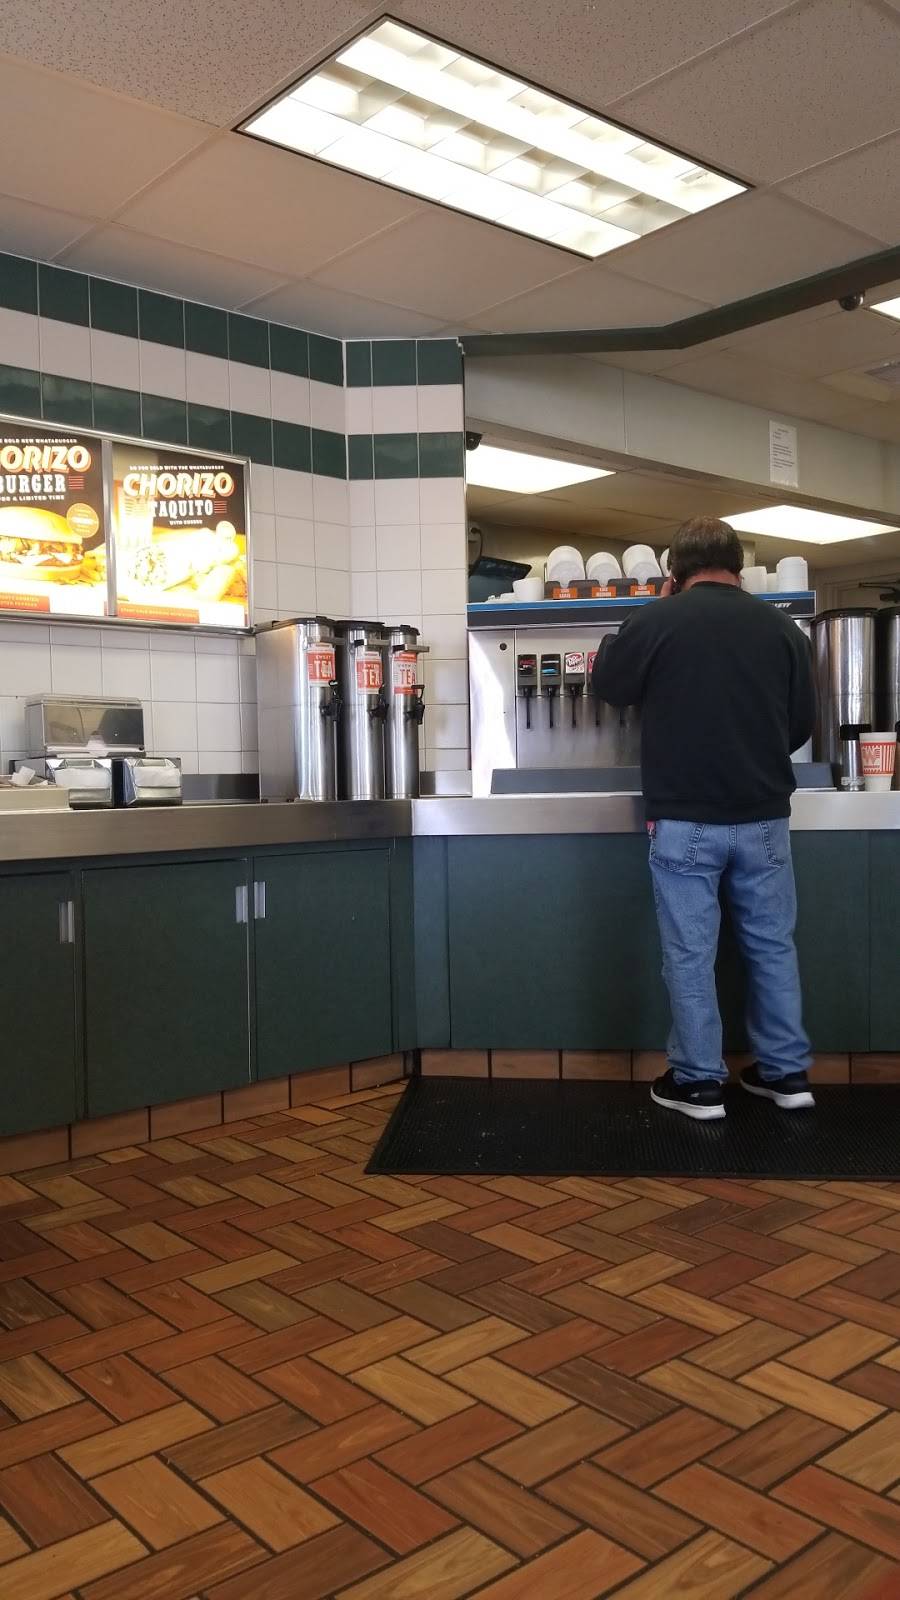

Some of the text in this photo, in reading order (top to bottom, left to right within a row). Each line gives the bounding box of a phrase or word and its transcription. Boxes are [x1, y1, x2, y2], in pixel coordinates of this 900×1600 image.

[0, 445, 91, 473] ORIZO
[122, 472, 235, 498] CHORIZO
[149, 499, 213, 519] TAQUITO
[313, 660, 332, 678] TEA
[362, 669, 380, 686] TEA
[399, 669, 416, 685] TEA
